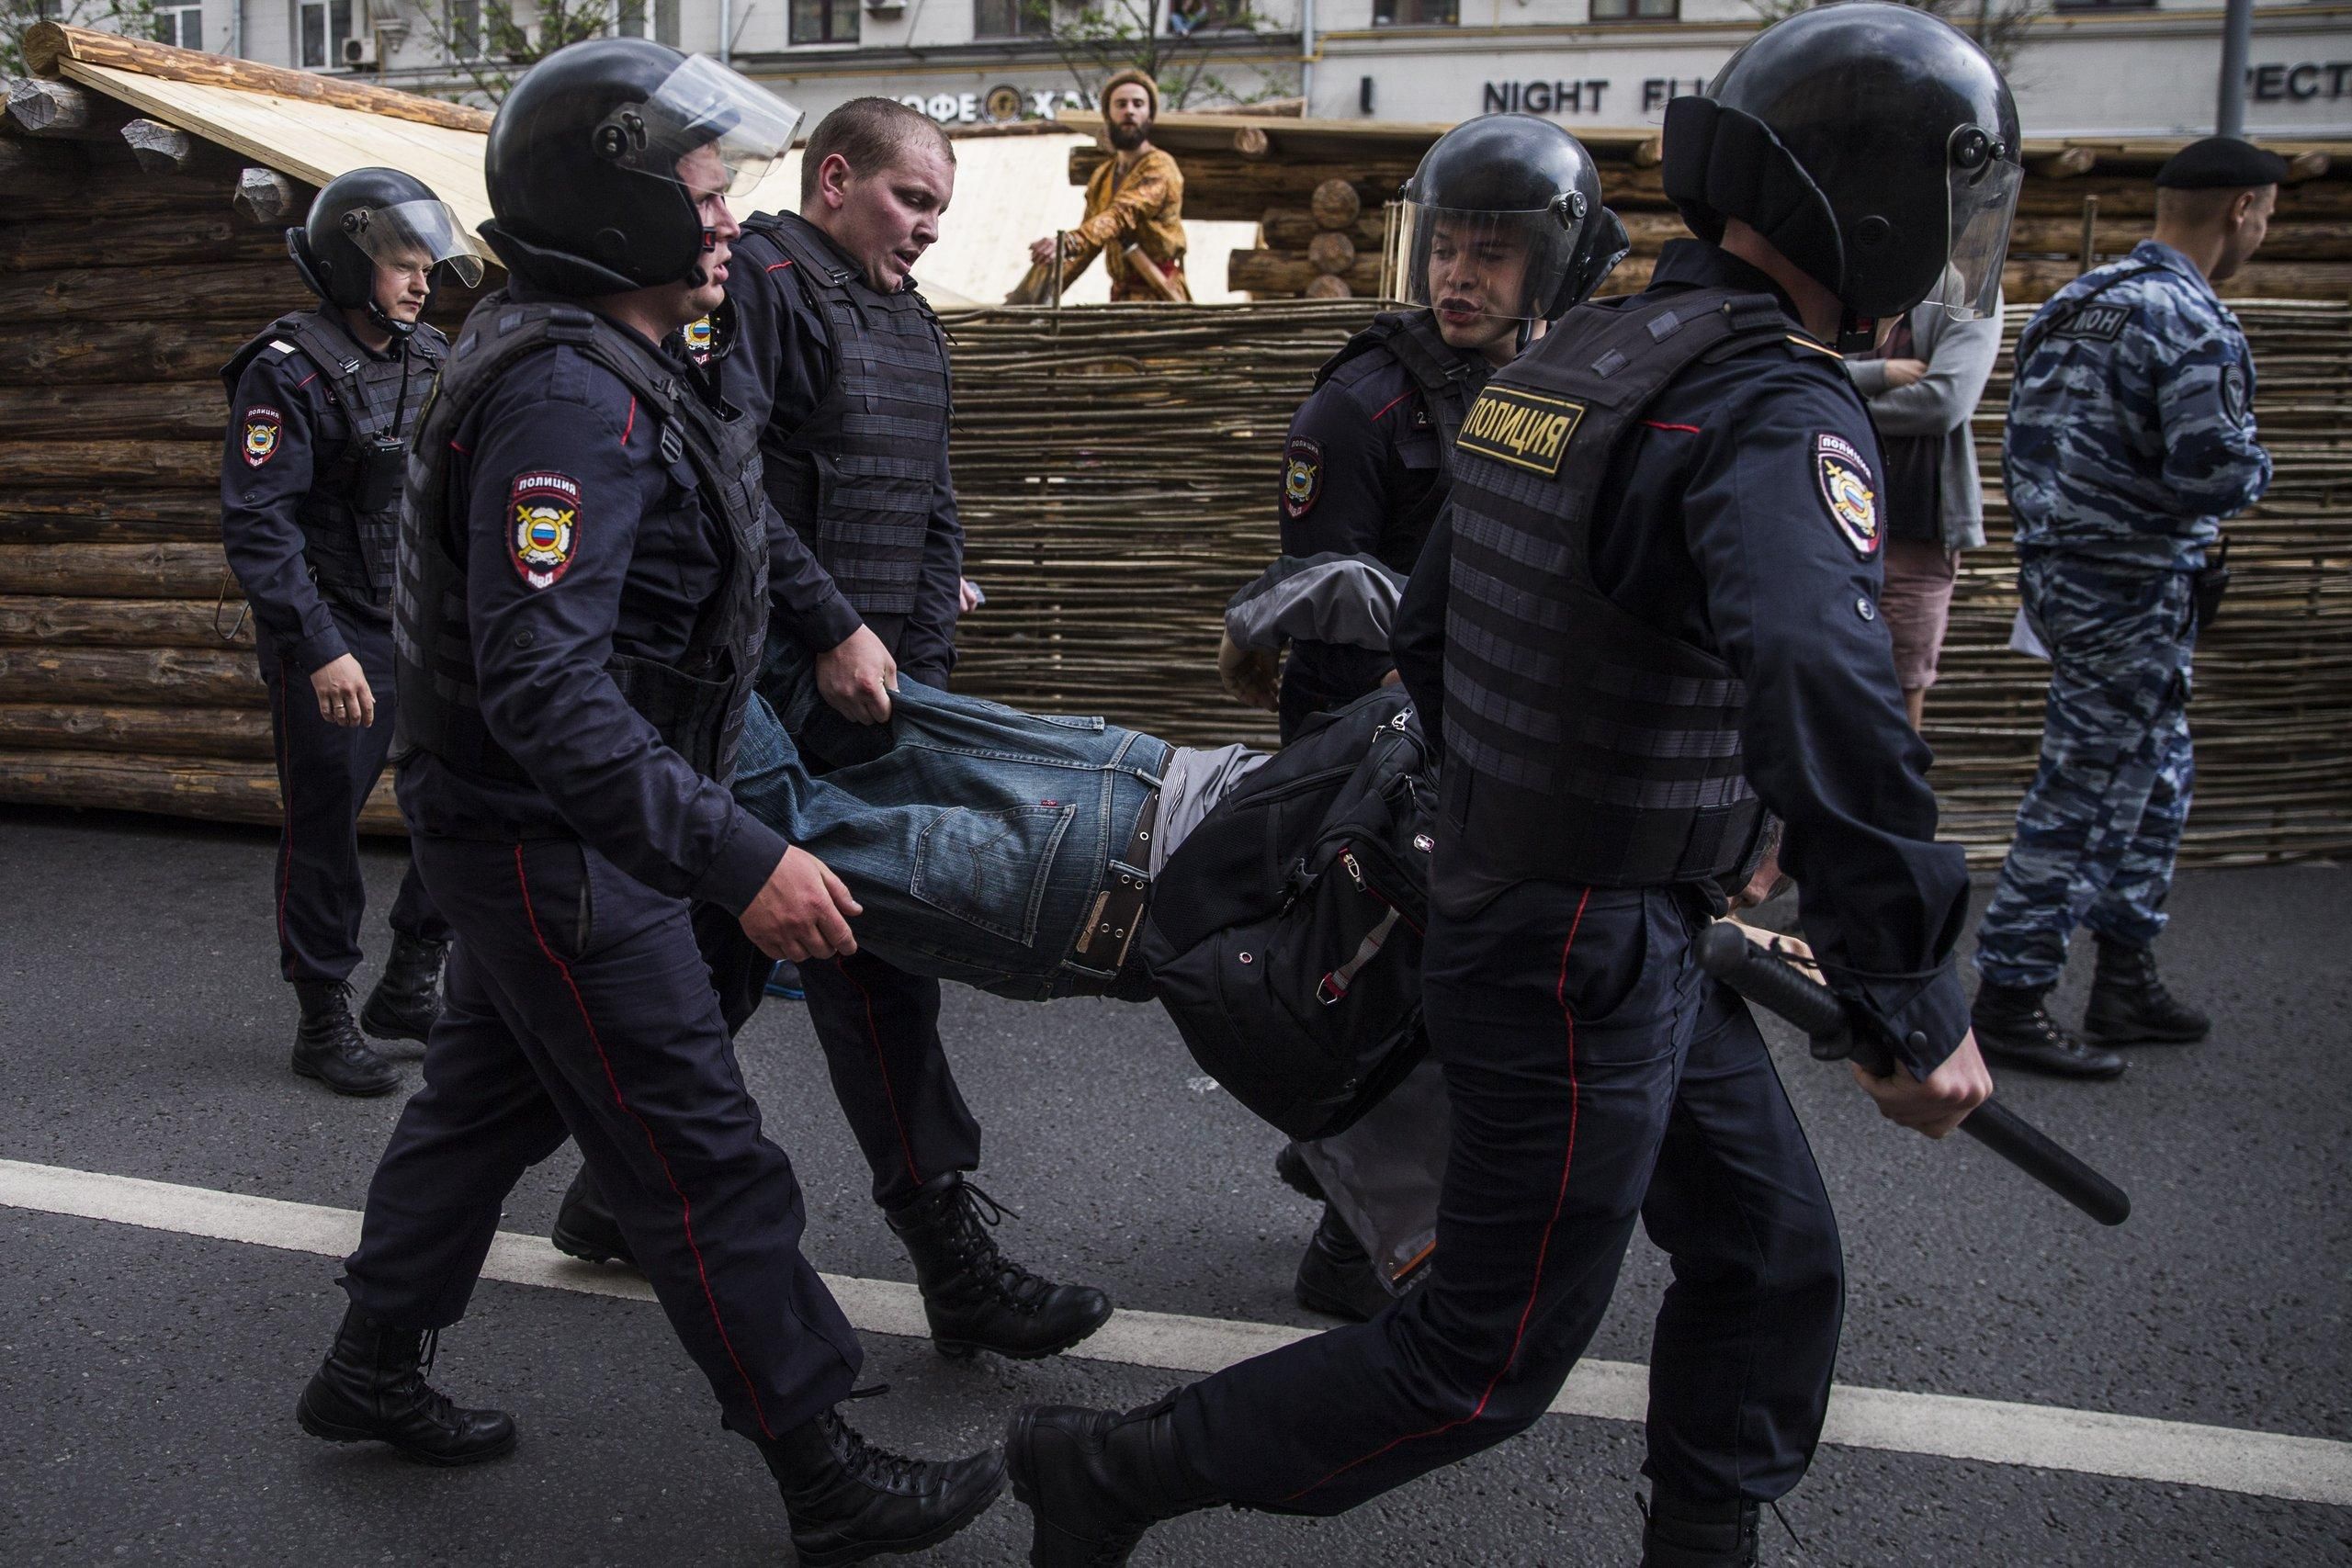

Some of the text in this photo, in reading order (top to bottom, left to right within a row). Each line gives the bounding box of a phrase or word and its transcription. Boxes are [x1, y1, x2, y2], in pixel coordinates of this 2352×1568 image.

[2245, 61, 2352, 101] ЕСТ
[1483, 79, 1610, 114] NIGHT
[889, 93, 978, 123] ОФЕ
[693, 354, 707, 365] ВД
[247, 408, 279, 419] ПОЛИЦИЯ
[1464, 397, 1571, 458] ПОЛИЦИЯ
[1291, 440, 1319, 456] ПОЛИЦИЯ
[518, 476, 577, 496] ПОЛИЦИЯ
[527, 570, 554, 589] МВД
